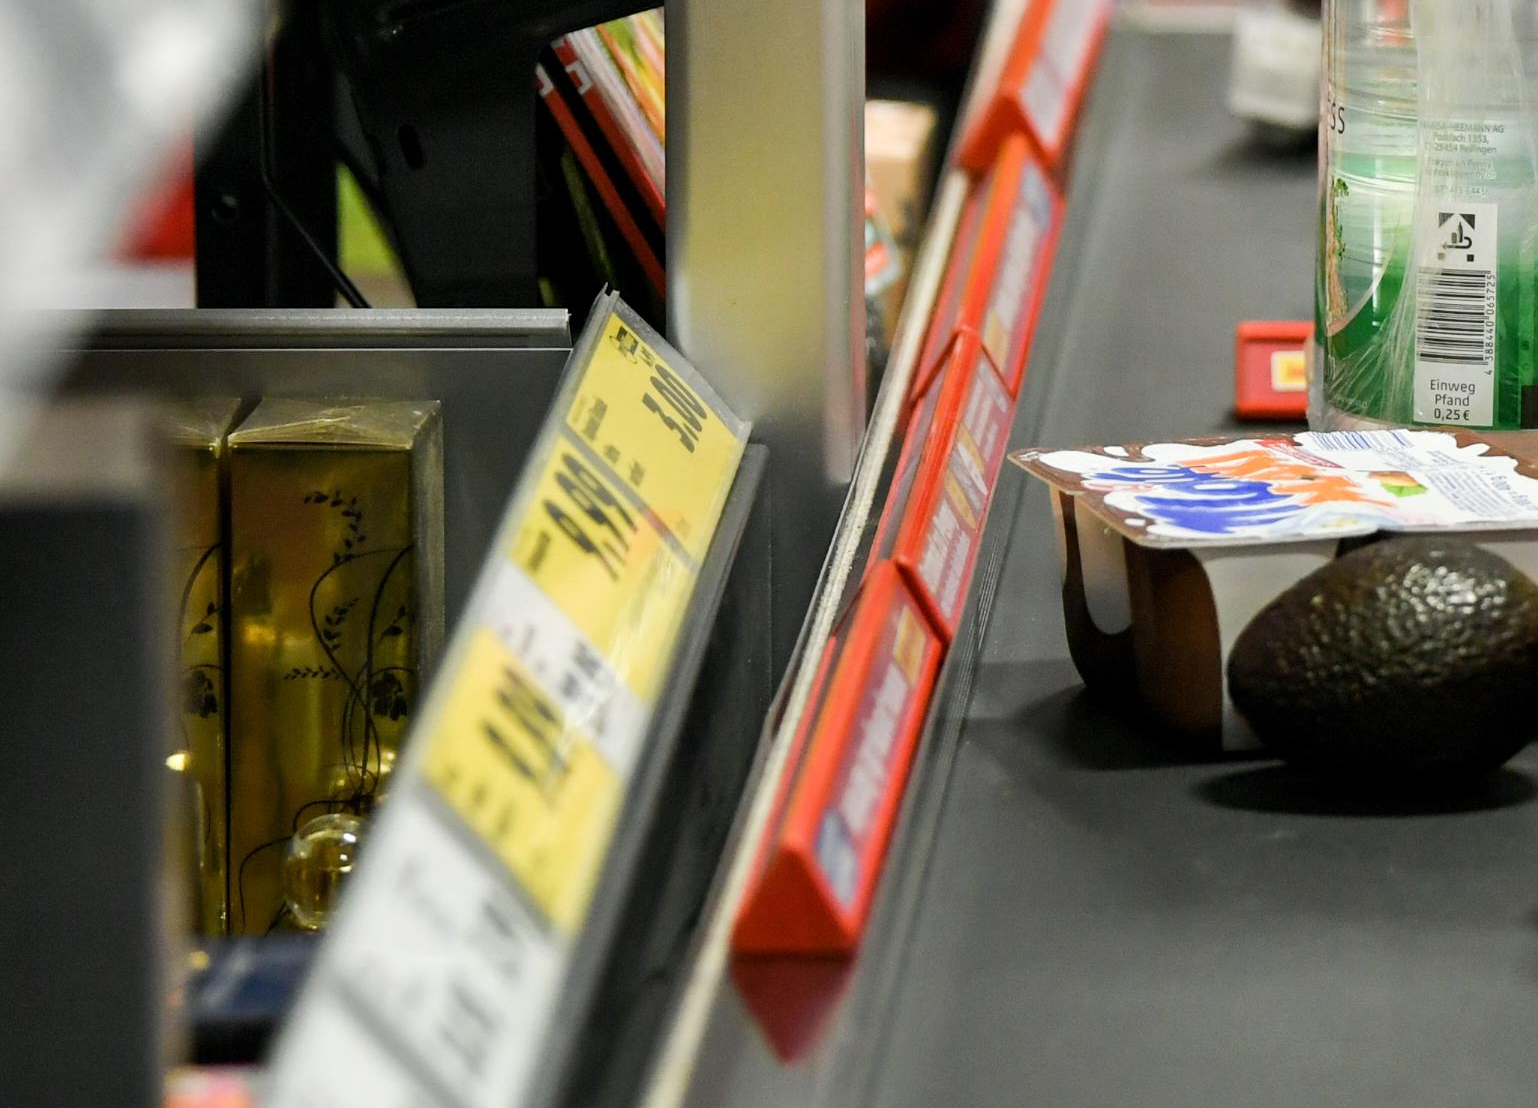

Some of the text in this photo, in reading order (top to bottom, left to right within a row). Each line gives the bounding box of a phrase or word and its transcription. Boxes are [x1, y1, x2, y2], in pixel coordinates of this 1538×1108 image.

[1430, 379, 1476, 394] Einweg
[1434, 394, 1470, 406] Pfand
[642, 363, 708, 454] 3,00
